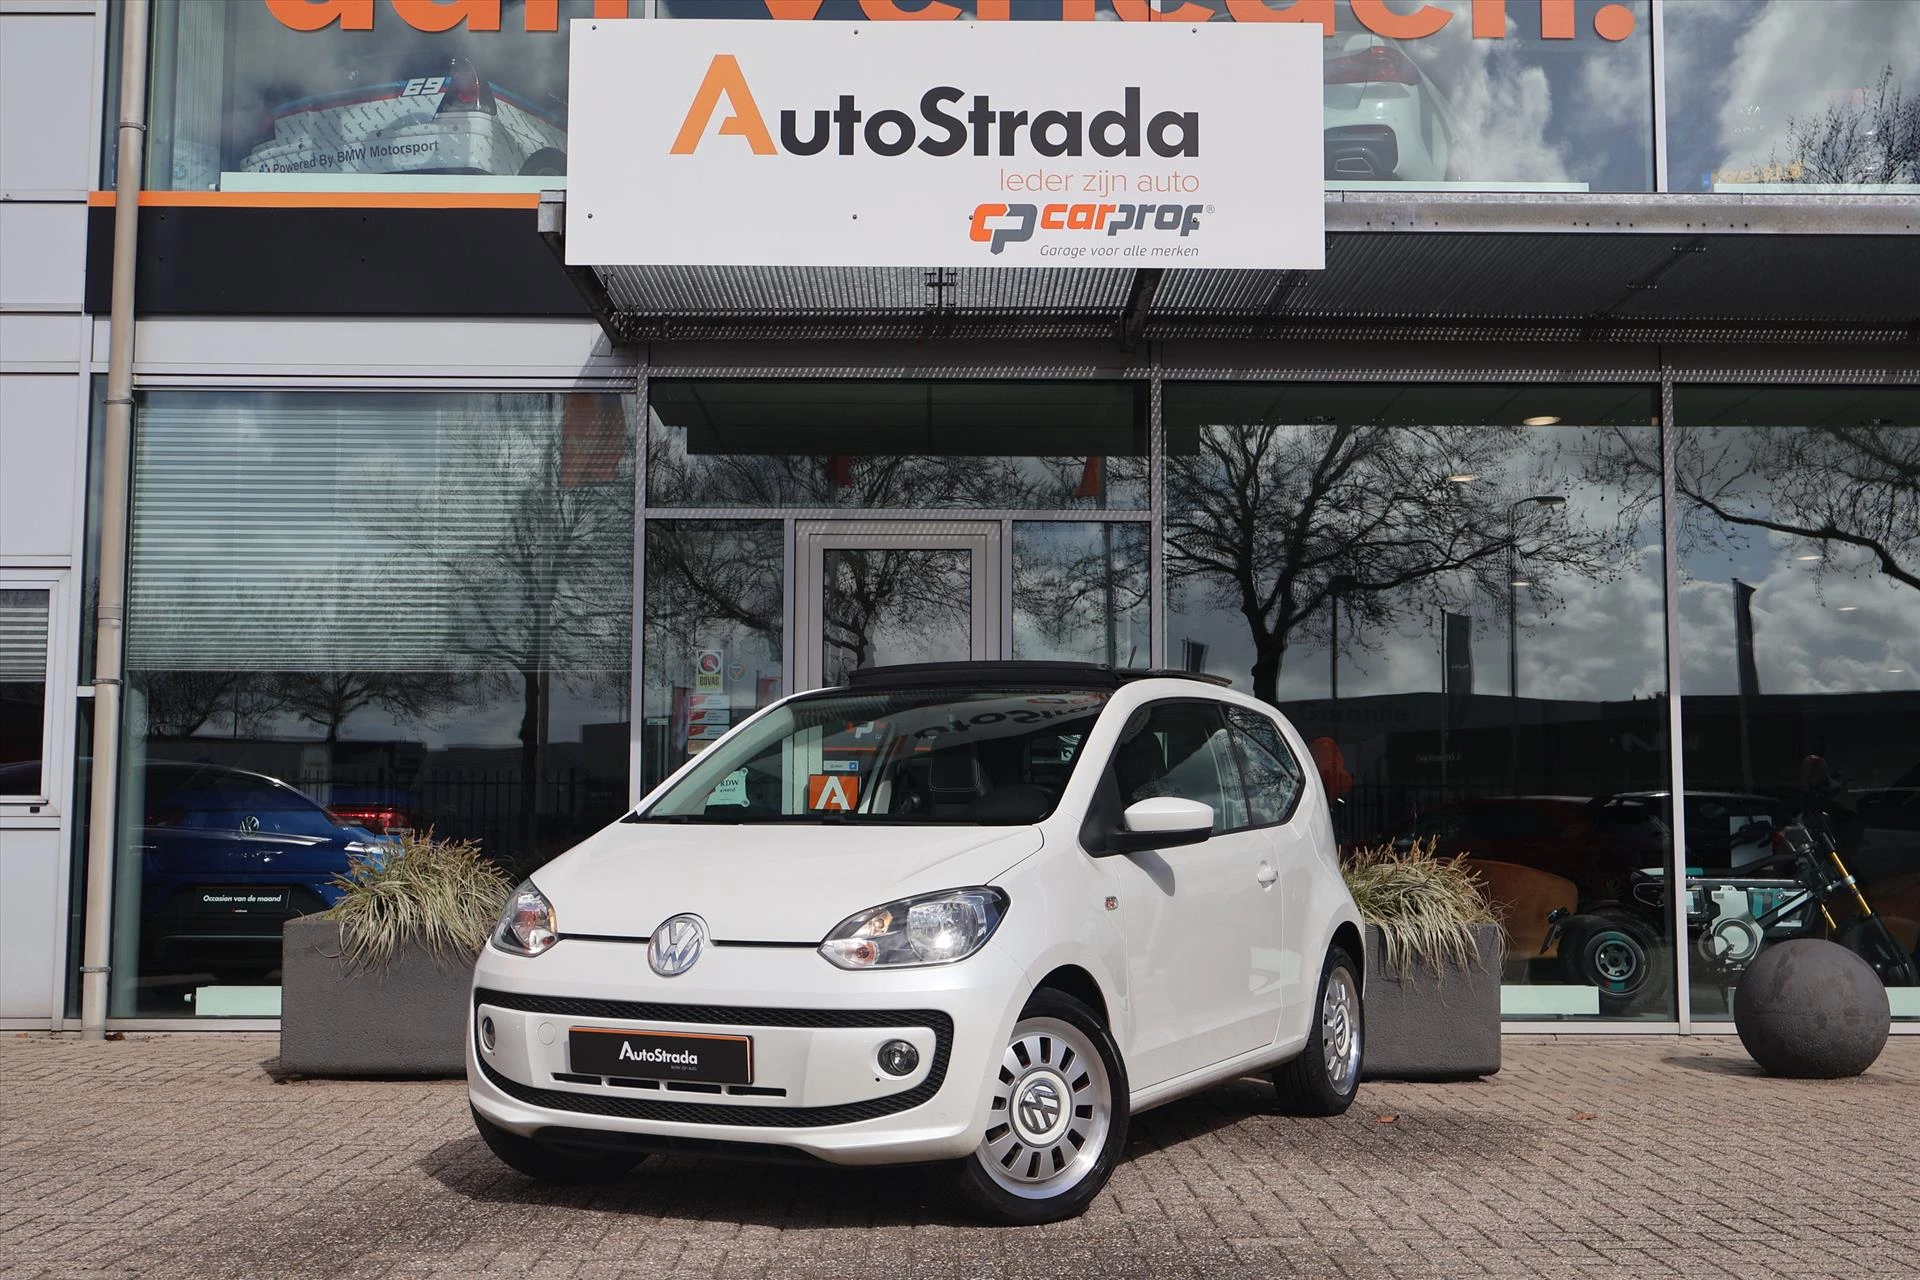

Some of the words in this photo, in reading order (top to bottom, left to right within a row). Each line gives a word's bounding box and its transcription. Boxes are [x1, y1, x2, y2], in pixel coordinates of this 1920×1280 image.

[402, 77, 445, 97] 69
[669, 54, 1200, 157] AutoStrada
[273, 156, 316, 173] Powered
[319, 154, 334, 168] By
[337, 148, 366, 163] BMW
[369, 140, 439, 159] Motorsport
[1000, 168, 1074, 192] Ieder
[1082, 170, 1127, 198] zijn
[1137, 171, 1200, 193] auto
[1040, 203, 1204, 237] carprof
[1040, 244, 1085, 259] Garage
[1089, 247, 1120, 257] voor
[1122, 244, 1148, 257] alle
[1151, 245, 1199, 257] merken
[815, 776, 851, 810] A
[203, 894, 233, 902] Occasion
[247, 894, 256, 902] de
[257, 894, 282, 902] maand
[619, 1040, 698, 1065] AutoStrada
